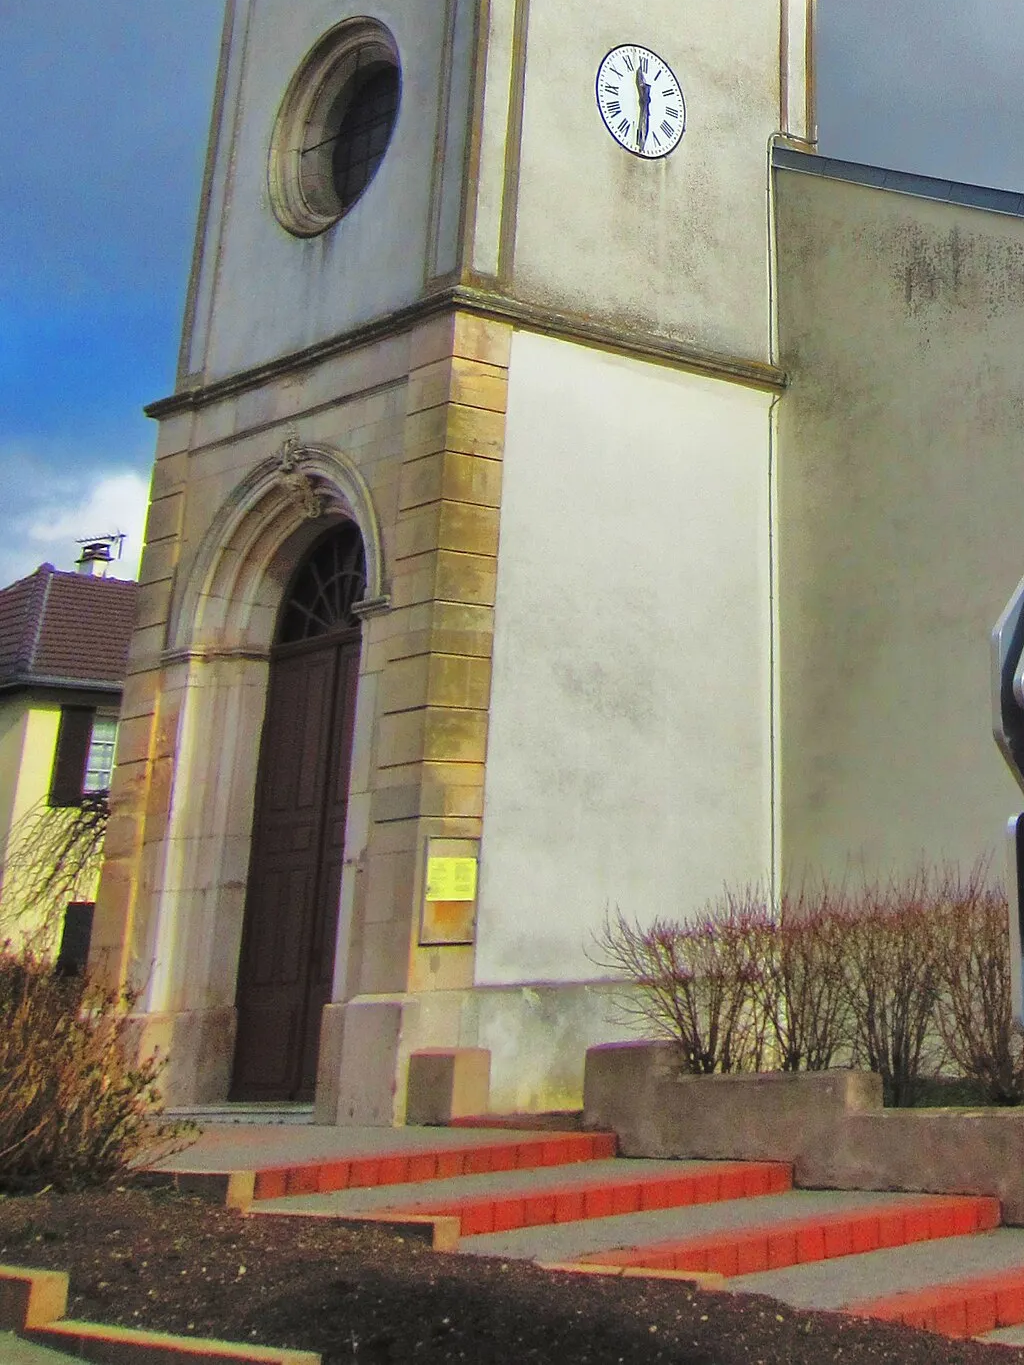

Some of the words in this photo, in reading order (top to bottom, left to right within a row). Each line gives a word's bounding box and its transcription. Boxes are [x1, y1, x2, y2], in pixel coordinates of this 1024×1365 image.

[609, 63, 623, 81] X
[653, 69, 662, 81] I
[661, 88, 675, 97] II
[665, 105, 679, 119] III
